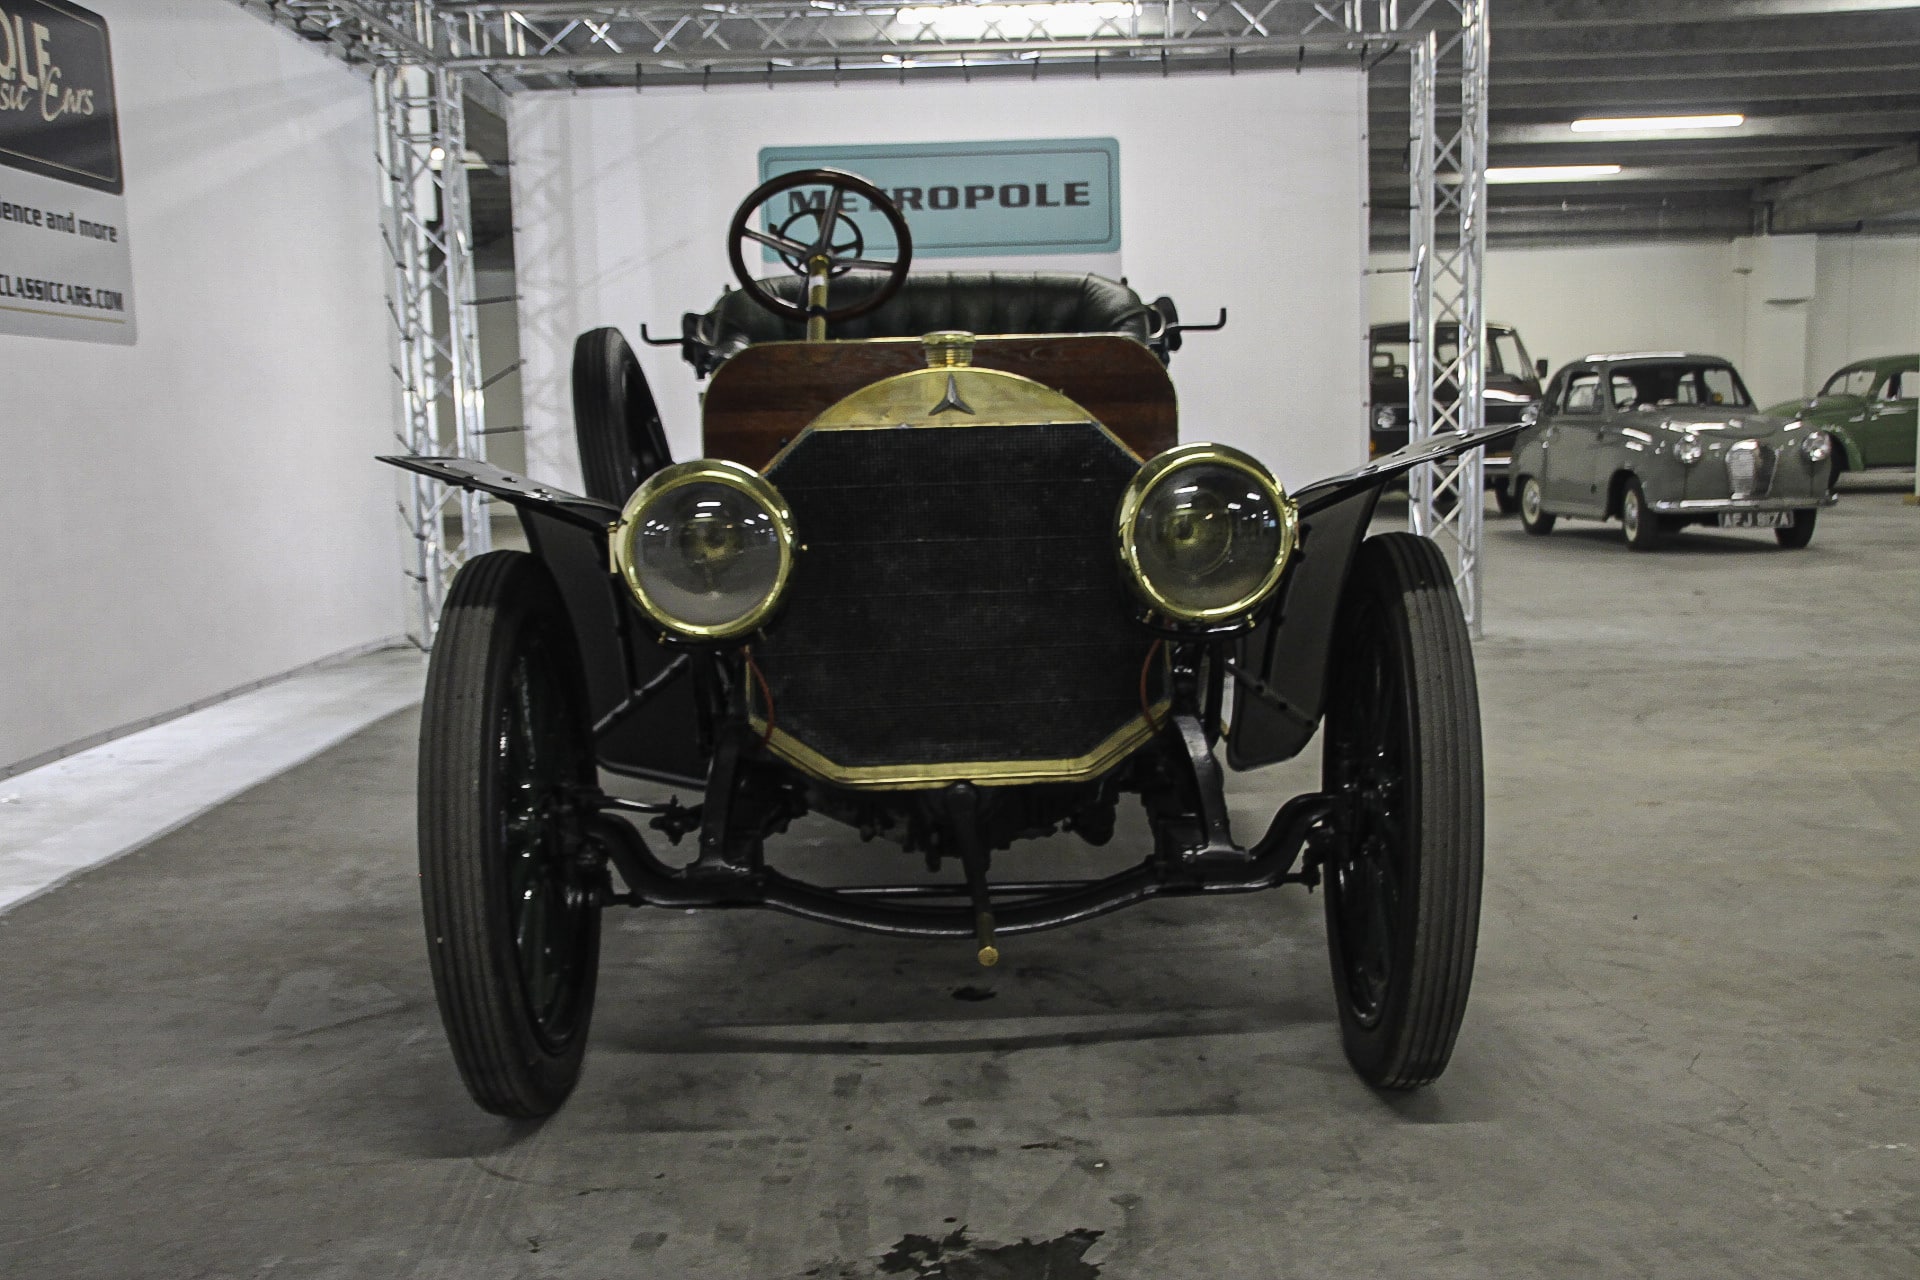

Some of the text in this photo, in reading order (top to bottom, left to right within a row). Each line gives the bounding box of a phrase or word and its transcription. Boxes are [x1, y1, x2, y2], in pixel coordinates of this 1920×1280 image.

[789, 182, 1090, 213] MEROPOLE
[46, 211, 76, 234] and
[79, 219, 118, 243] more
